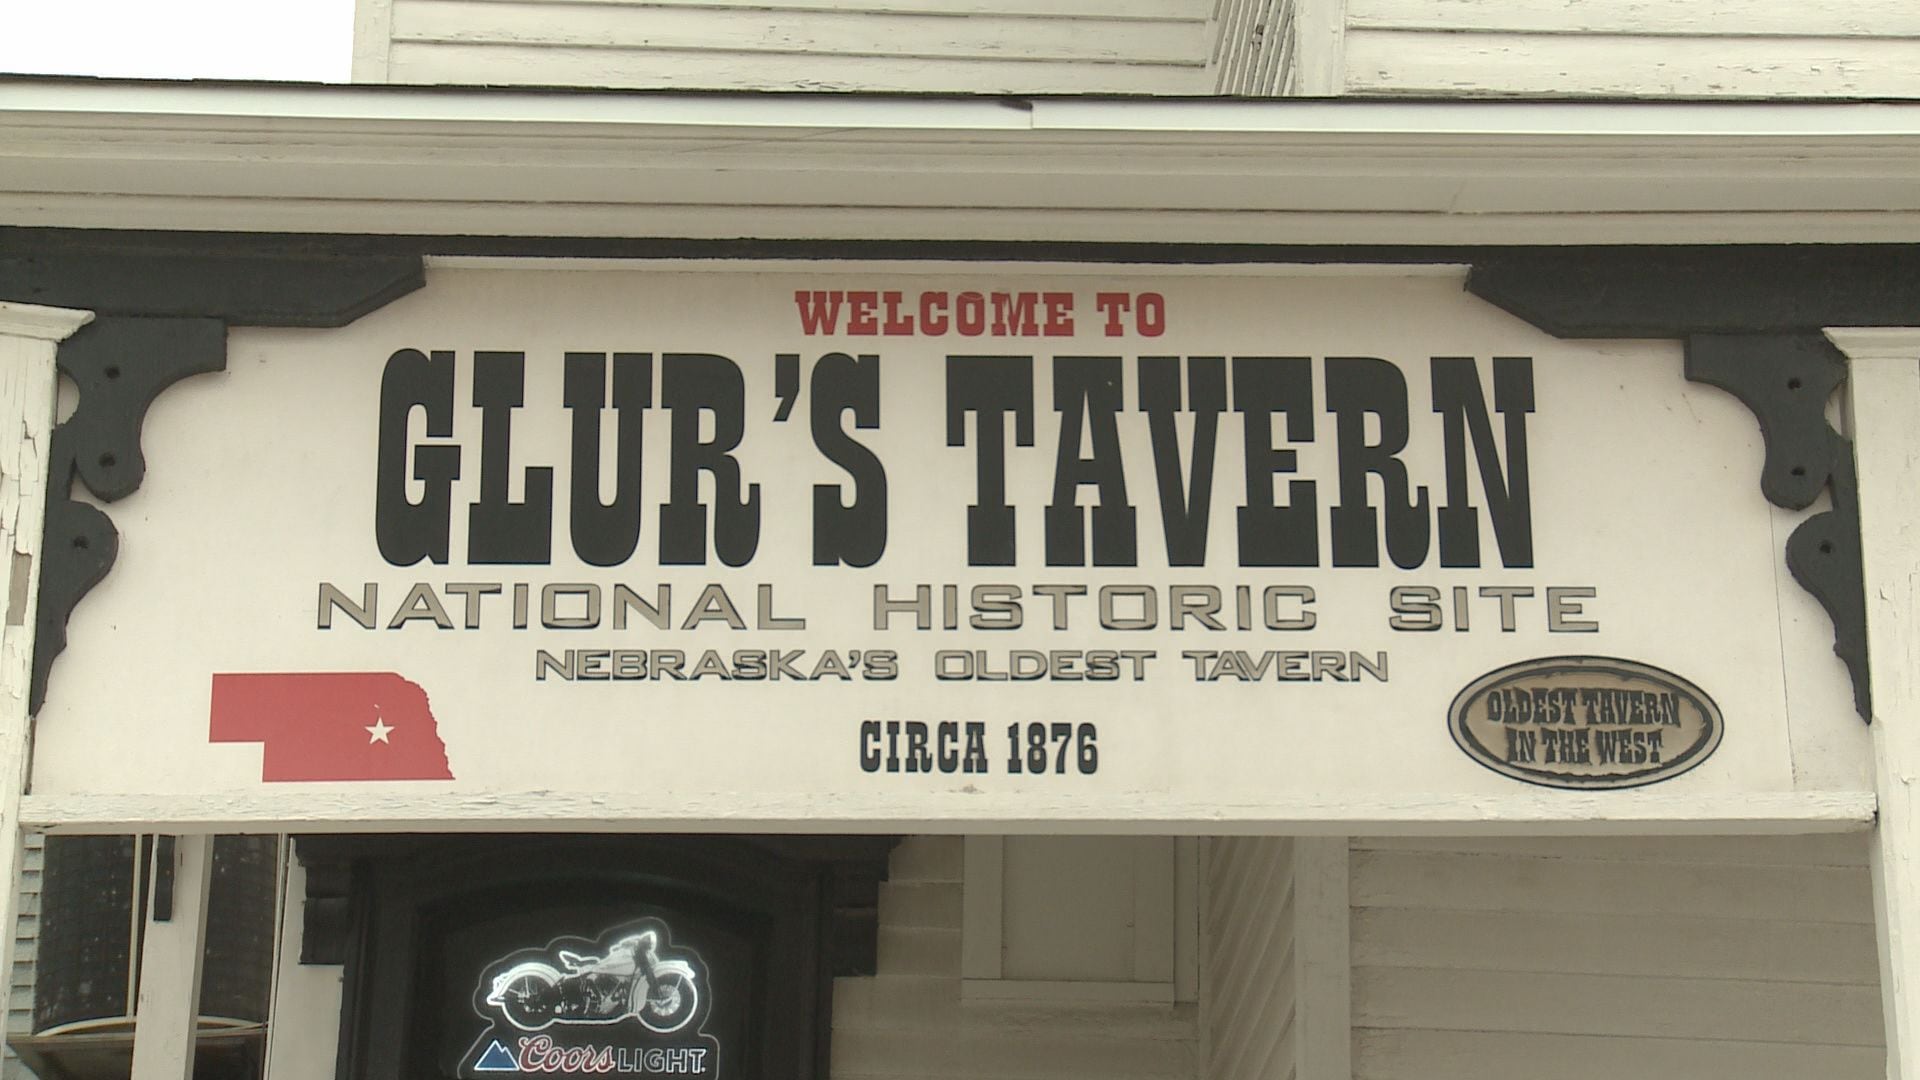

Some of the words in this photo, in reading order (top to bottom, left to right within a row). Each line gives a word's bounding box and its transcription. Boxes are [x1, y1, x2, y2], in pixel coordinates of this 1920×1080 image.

[794, 290, 1074, 336] WELCOME
[1096, 292, 1166, 337] TO
[375, 348, 888, 567] GLUR'S
[945, 355, 1536, 570] TAVERN
[318, 582, 806, 631] NATIONAL
[873, 584, 1318, 632] HISTORIC
[1388, 585, 1600, 633] SITE
[536, 648, 898, 681] NEBRASKA'S
[935, 650, 1157, 682] OLDEST
[1182, 651, 1389, 683] TAVERN
[1486, 686, 1577, 725] OLDEST
[1579, 687, 1681, 728] TAVERN
[860, 720, 989, 774] CIRCA
[1006, 722, 1099, 775] 1876
[1505, 726, 1537, 763] IN
[1540, 727, 1592, 766] THE
[1595, 728, 1663, 766] WEST
[518, 1034, 616, 1073] Coors
